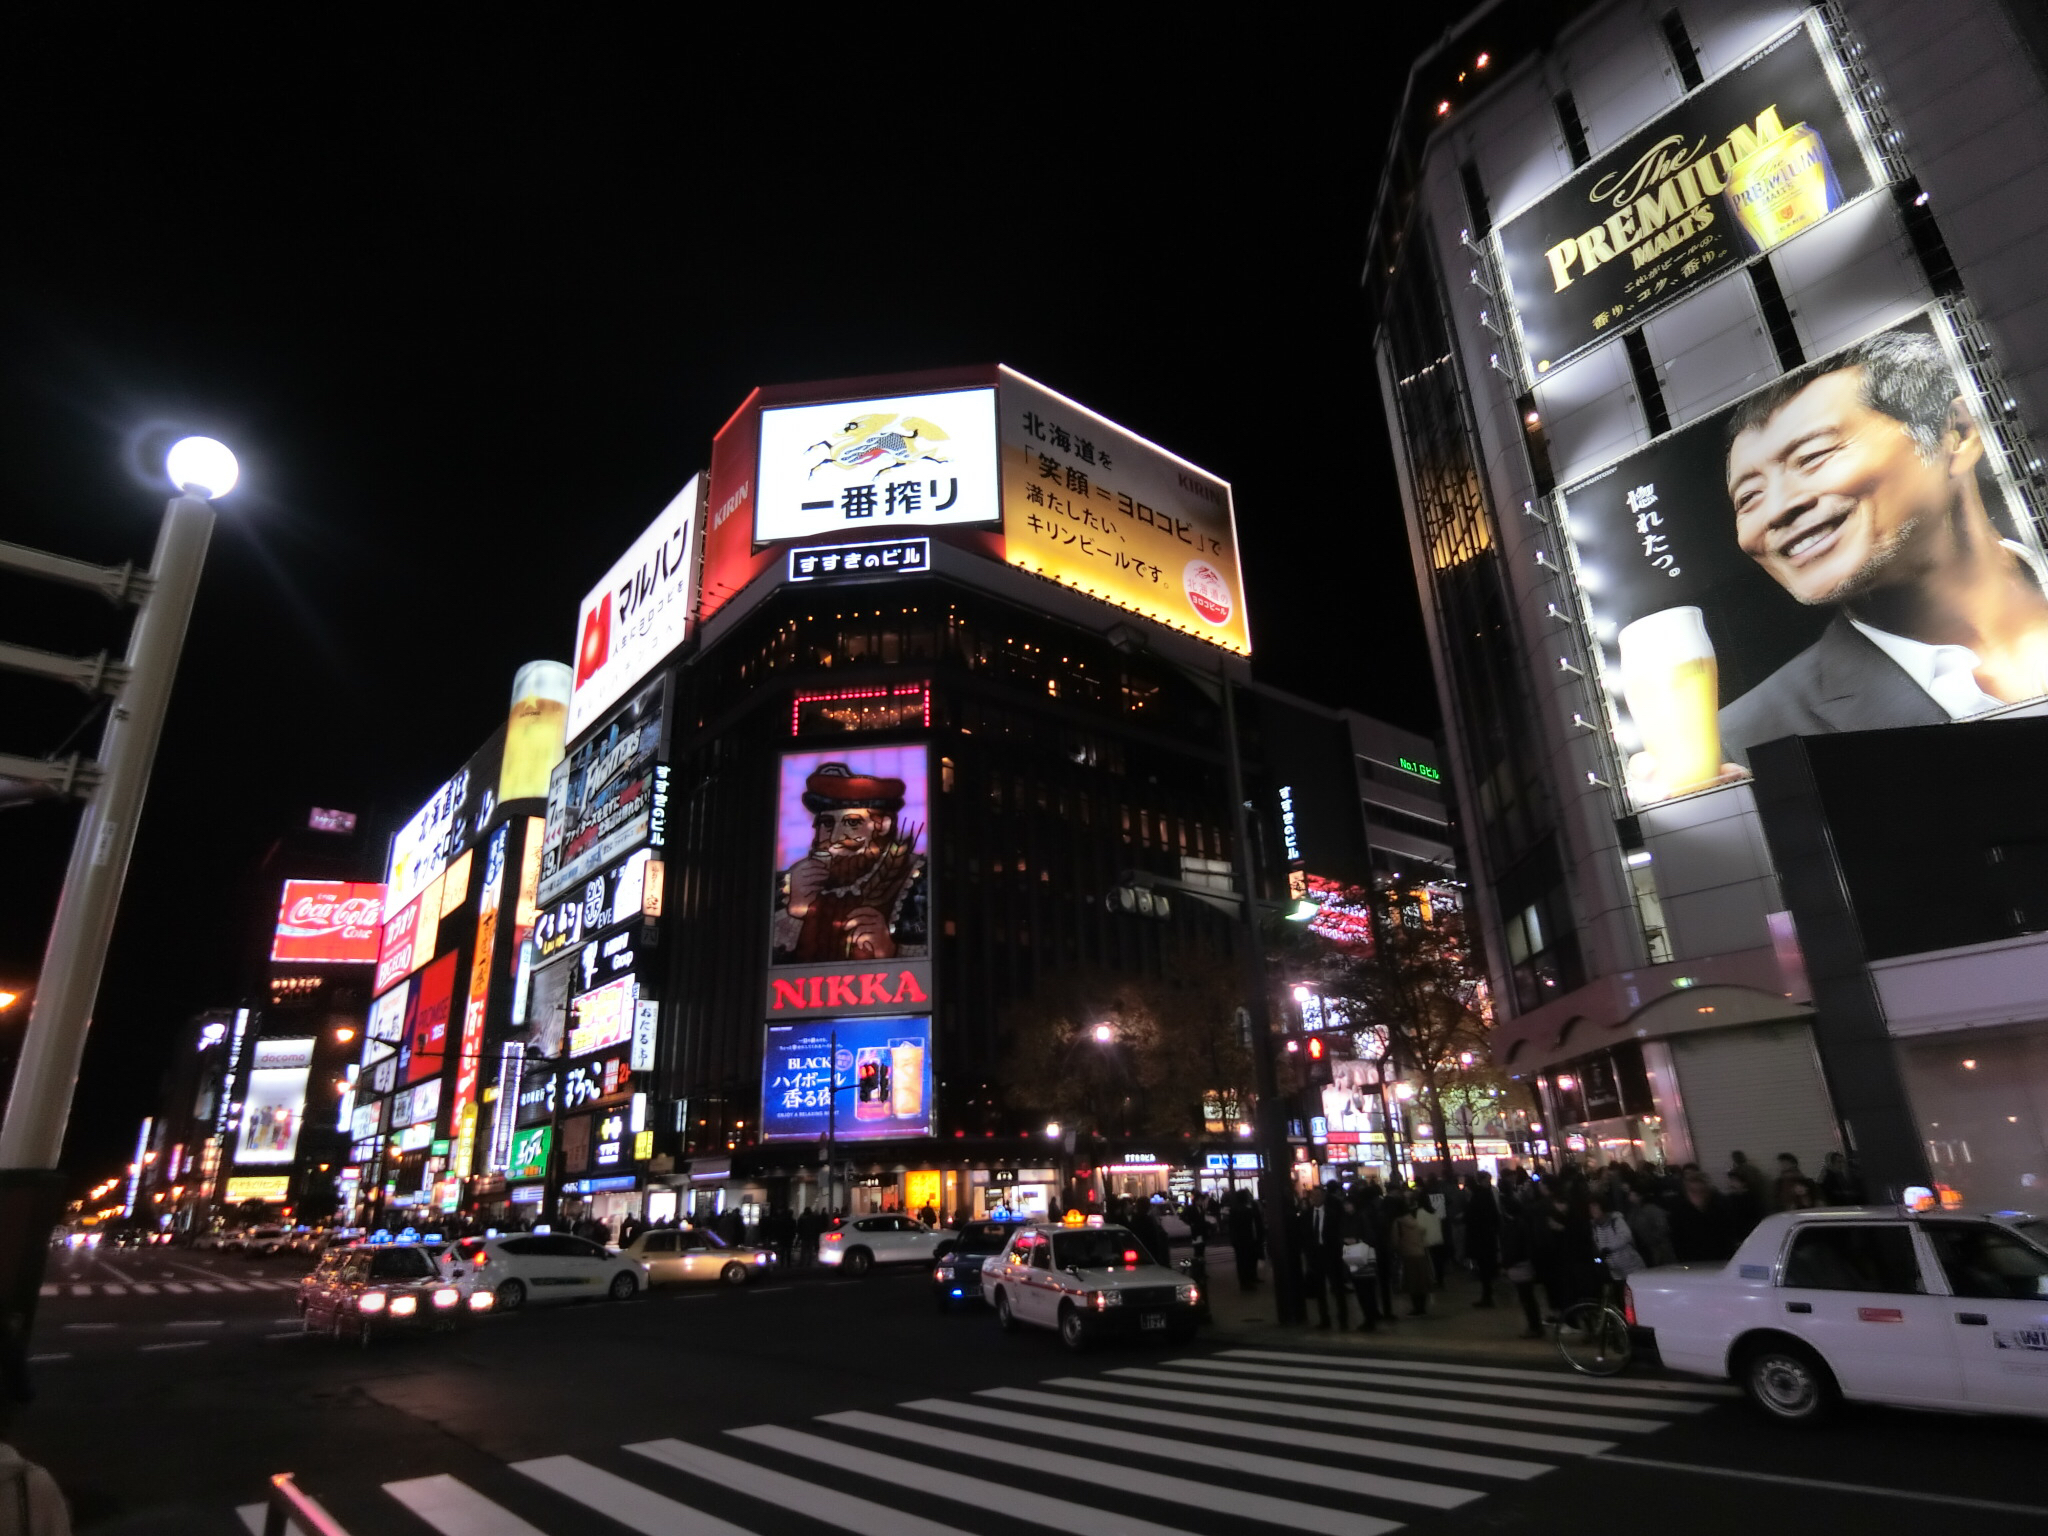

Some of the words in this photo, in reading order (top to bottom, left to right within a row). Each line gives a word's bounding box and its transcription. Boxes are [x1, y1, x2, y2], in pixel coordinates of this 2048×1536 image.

[1589, 134, 1707, 208] The
[1544, 104, 1786, 293] PREMIUM
[1631, 203, 1715, 270] MALT'S
[1022, 411, 1113, 471] 北海道を
[713, 480, 749, 531] KIRIN
[800, 477, 959, 520] 一番搾り
[1177, 471, 1222, 505] KIRIN
[1026, 481, 1126, 543] 満たしたい、
[618, 518, 689, 626] マルハン
[799, 547, 921, 574] すすきのビル
[1027, 514, 1170, 590] キリンビールです。
[650, 765, 671, 846] すすきのビル
[289, 896, 381, 927] Coca-Cola
[772, 970, 928, 1010] NIKKA
[261, 1052, 306, 1063] docomo
[772, 1071, 847, 1088] ハイボール
[787, 1056, 831, 1070] BLACK
[782, 1086, 832, 1108] 香る夜
